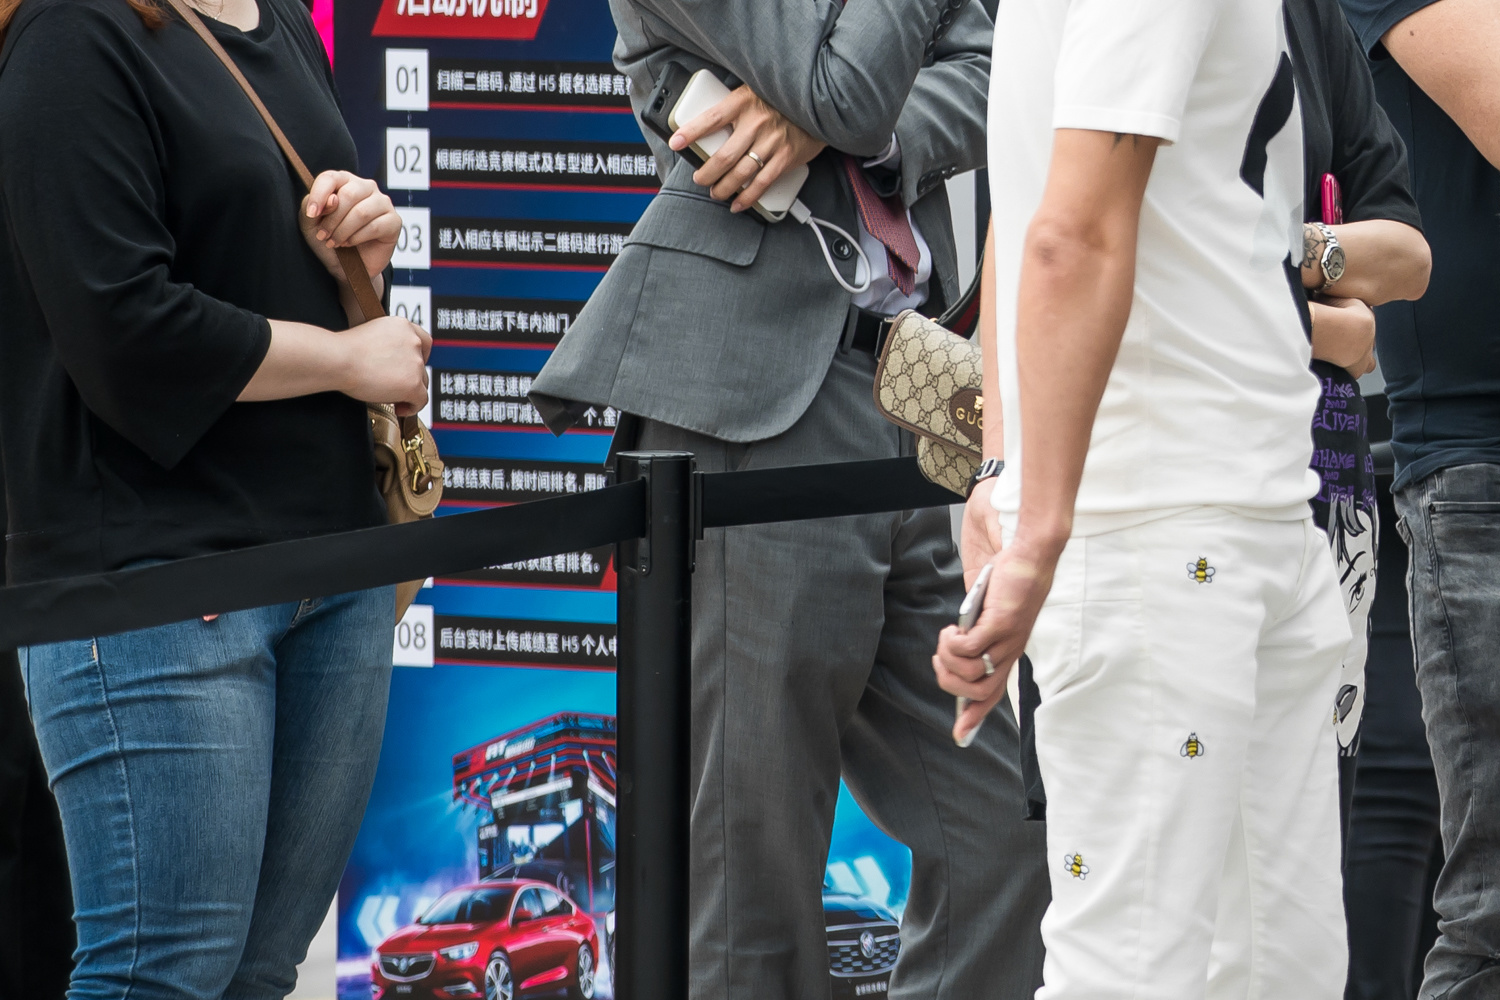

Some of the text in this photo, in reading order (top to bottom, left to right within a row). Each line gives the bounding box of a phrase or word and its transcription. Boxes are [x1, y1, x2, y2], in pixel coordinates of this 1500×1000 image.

[396, 65, 420, 94] 01
[539, 74, 557, 92] H5
[394, 145, 422, 173] 02
[439, 228, 630, 255] 进入相应车辆出示二维码进行游
[398, 621, 426, 650] 08
[562, 634, 580, 653] H5
